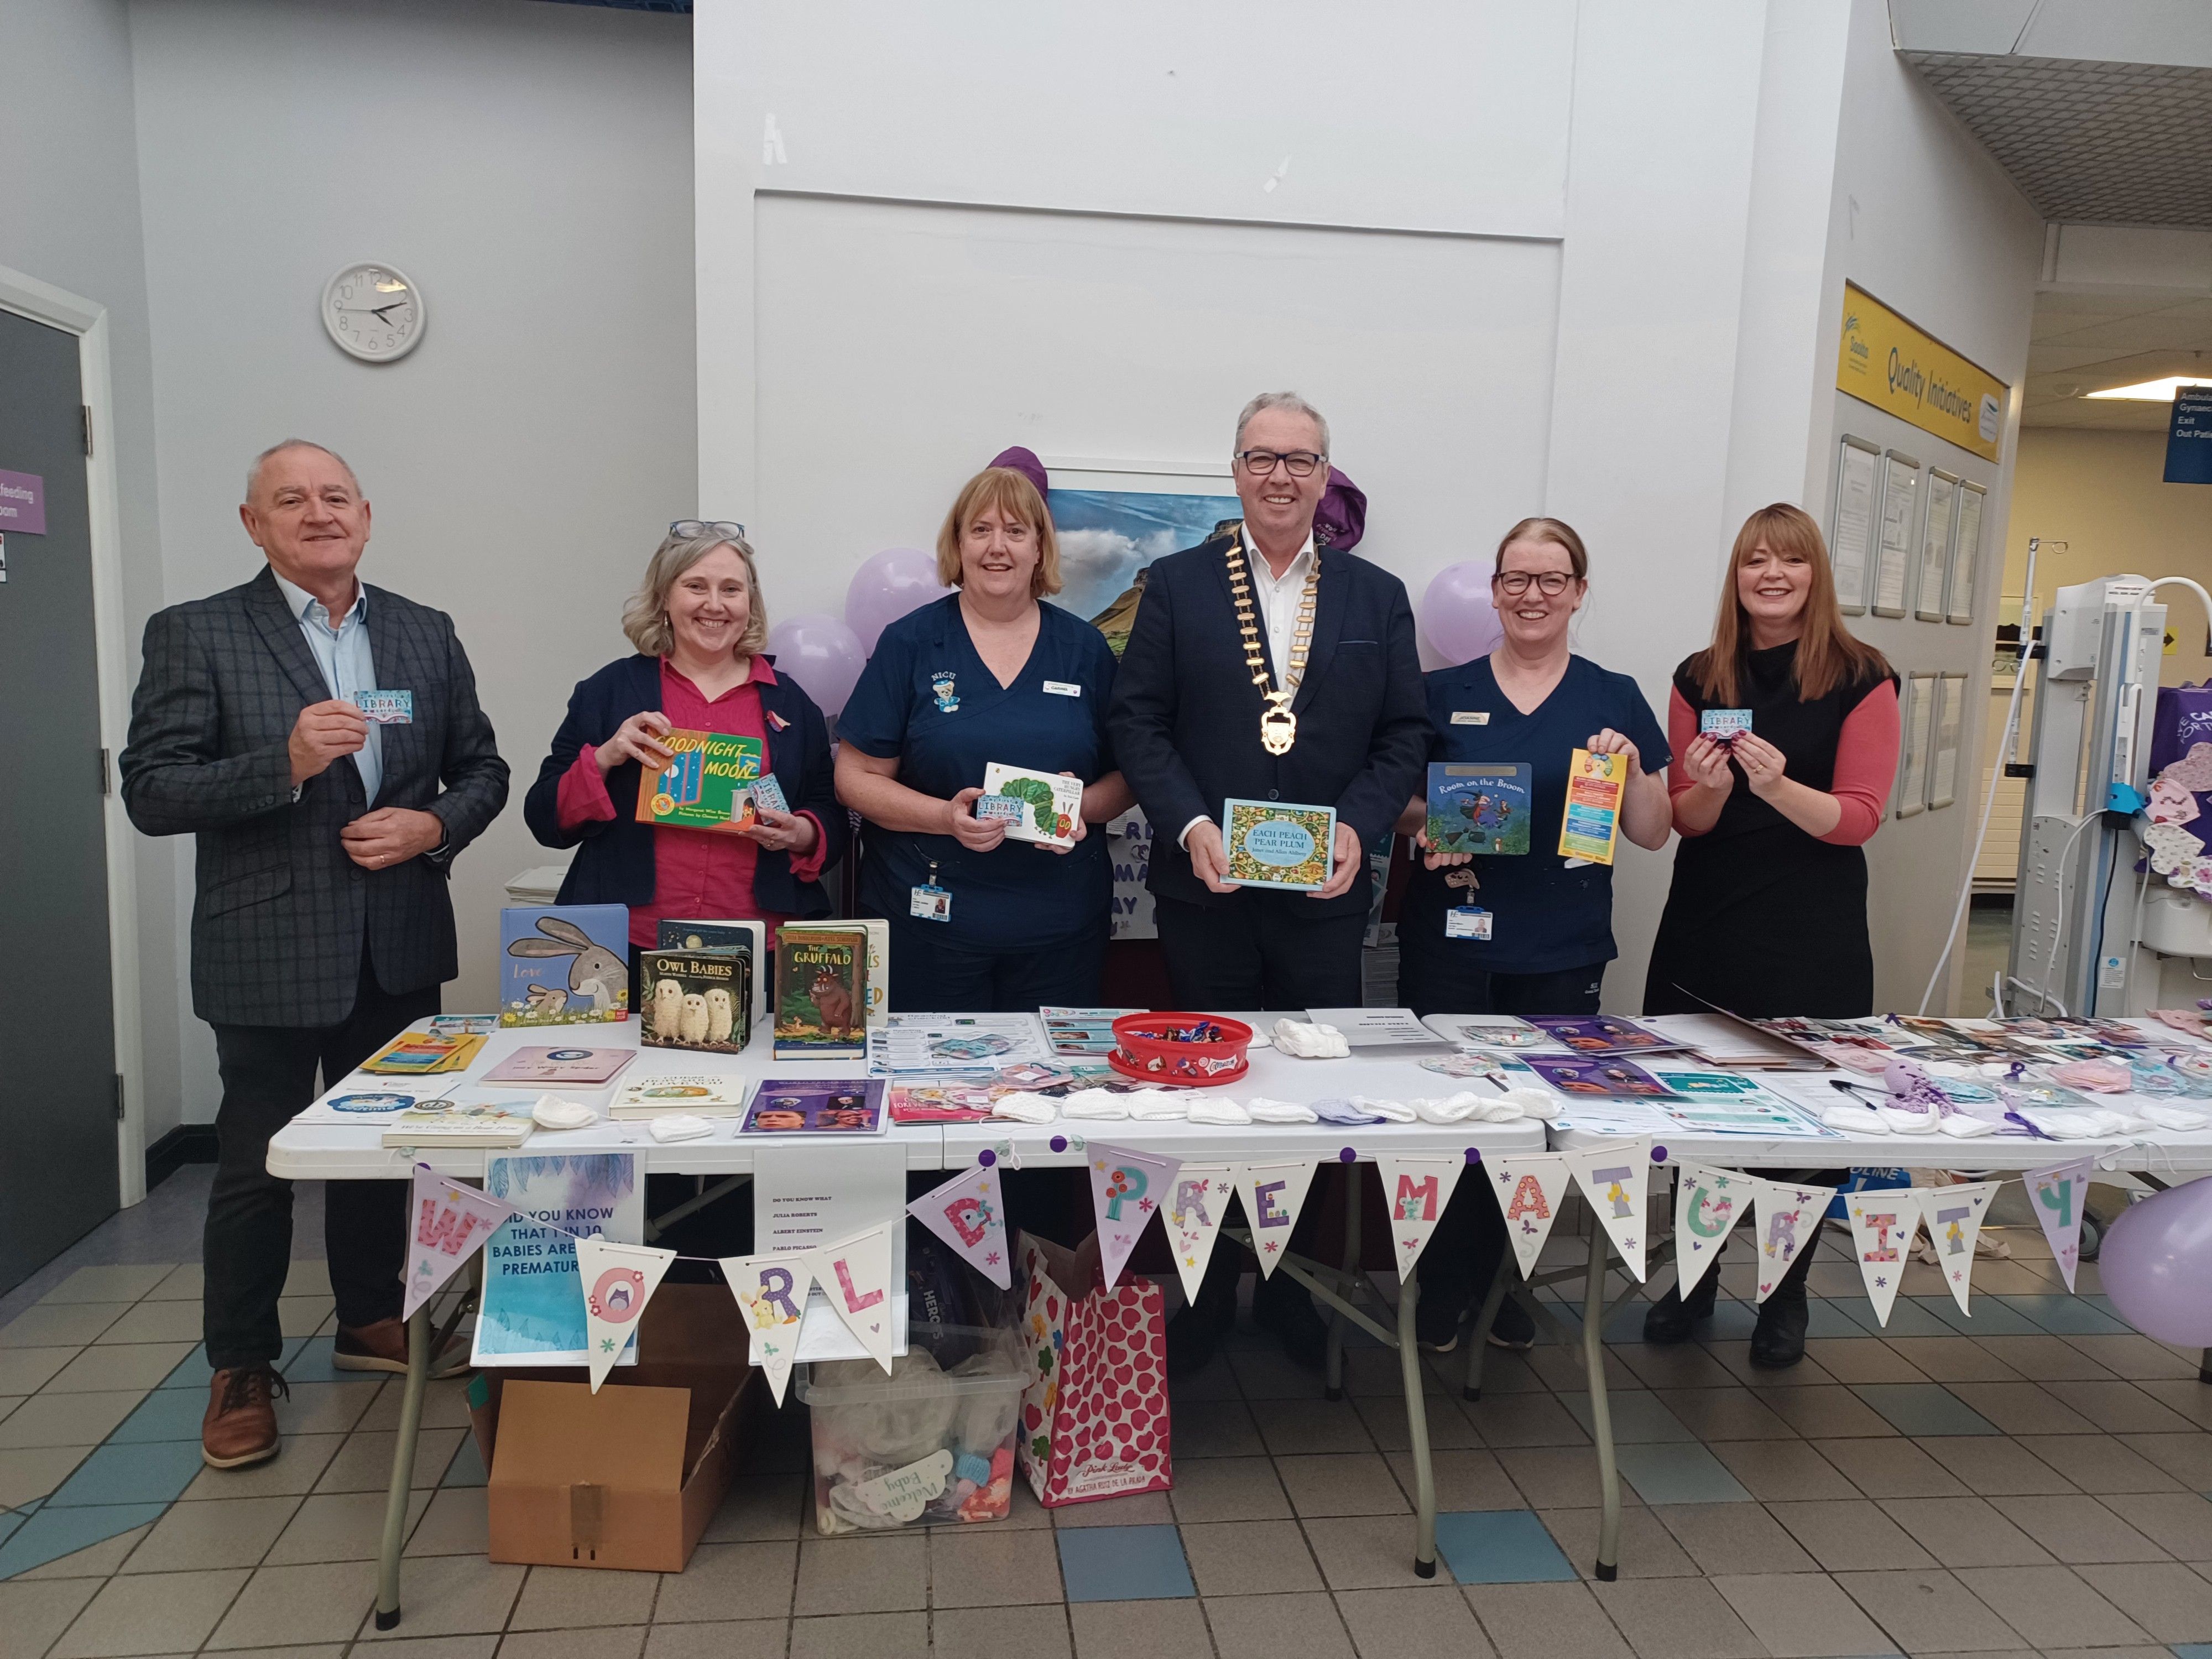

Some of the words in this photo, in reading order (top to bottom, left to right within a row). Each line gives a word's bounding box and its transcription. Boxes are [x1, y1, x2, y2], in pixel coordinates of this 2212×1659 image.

[354, 275, 363, 287] 11
[340, 285, 353, 300] 10
[399, 291, 408, 304] 2
[333, 300, 343, 313] 9
[404, 308, 414, 323] 3
[339, 316, 348, 331] 8
[396, 324, 406, 337] 4
[353, 330, 361, 342] 7
[386, 334, 395, 348] 5
[368, 337, 378, 351] 6
[1888, 347, 1926, 410] Quality
[1927, 370, 1972, 423] Initiatives
[2178, 416, 2195, 425] Exit
[2176, 429, 2192, 437] Out
[931, 671, 956, 681] NICU
[356, 699, 410, 708] LIBRARY
[1703, 717, 1750, 726] LIBRARY
[655, 735, 748, 758] GOODNIGHT
[704, 761, 753, 779] MOON
[1438, 782, 1465, 795] Room
[1479, 778, 1494, 786] the
[1497, 779, 1526, 794] Broom
[978, 801, 1022, 812] LIBRARY
[1253, 830, 1276, 838] EACH
[1279, 831, 1307, 841] PEACH
[1254, 838, 1277, 847] PEAR
[1280, 840, 1305, 849] PLUM
[794, 951, 851, 964] GRUFFALO
[513, 964, 542, 979] Love
[529, 1210, 560, 1222] YOU
[566, 1207, 614, 1220] KNOW
[510, 1227, 547, 1240] THAT
[564, 1226, 579, 1238] IN
[585, 1225, 602, 1235] 10
[493, 1244, 542, 1258] BABIES
[547, 1243, 576, 1255] ARE
[503, 1260, 580, 1275] PREMATUR
[1082, 1464, 1107, 1478] Pink
[1107, 1462, 1135, 1473] Lady
[884, 1472, 922, 1493] Baby
[1076, 1484, 1097, 1493] AGATHA
[1098, 1481, 1110, 1490] RUIZ
[1112, 1479, 1118, 1487] DE
[1120, 1478, 1128, 1486] LA
[1129, 1475, 1145, 1484] PRADA
[881, 1482, 938, 1511] Welcome
